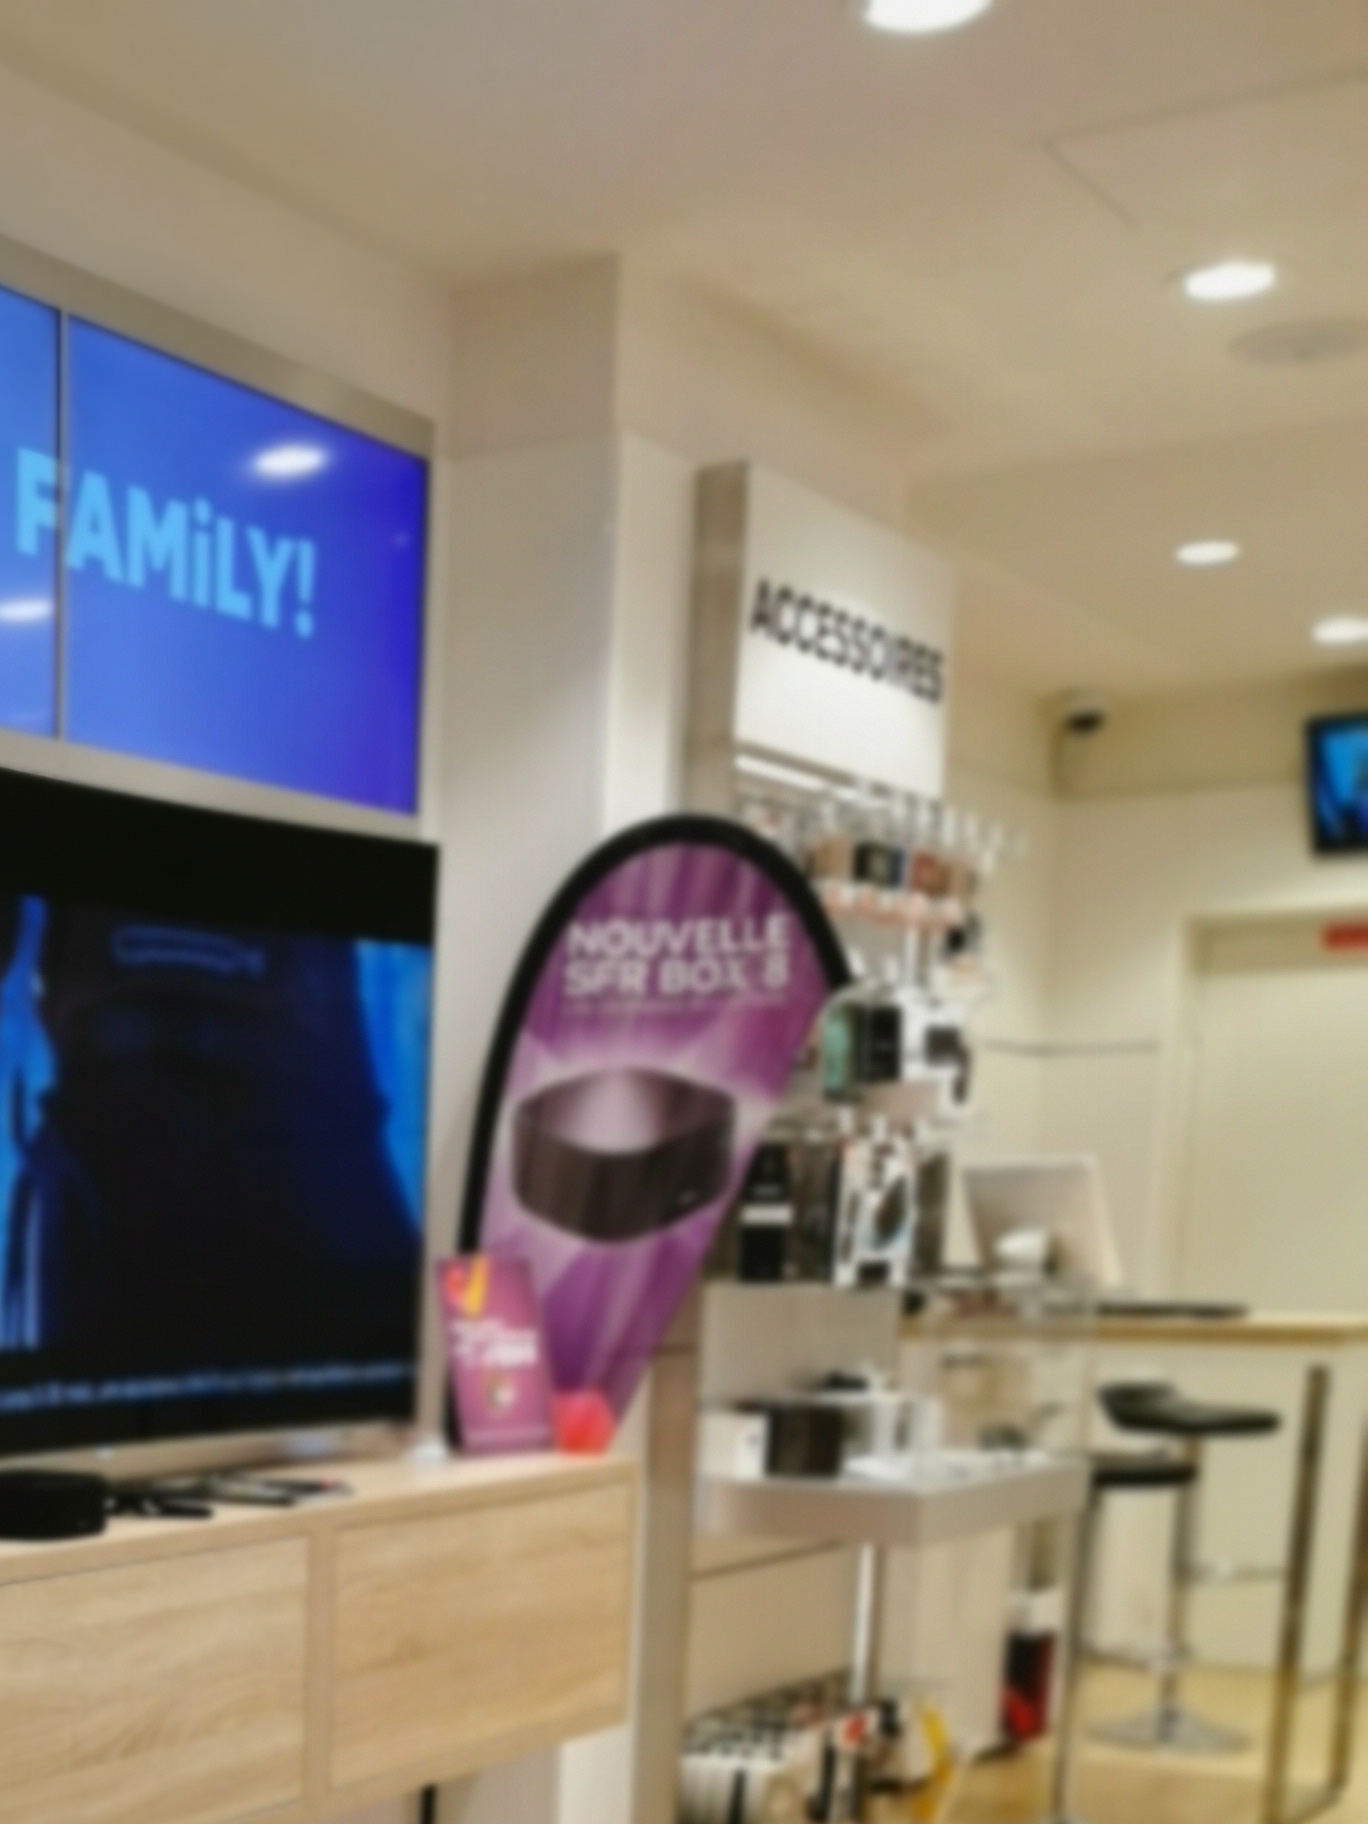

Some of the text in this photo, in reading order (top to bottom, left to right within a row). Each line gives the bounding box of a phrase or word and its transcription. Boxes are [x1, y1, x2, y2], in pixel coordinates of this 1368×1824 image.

[751, 577, 943, 703] ACCESSOIRES
[566, 914, 790, 957] NOUVELLE
[564, 958, 649, 997] SFR
[658, 957, 746, 994] BOX
